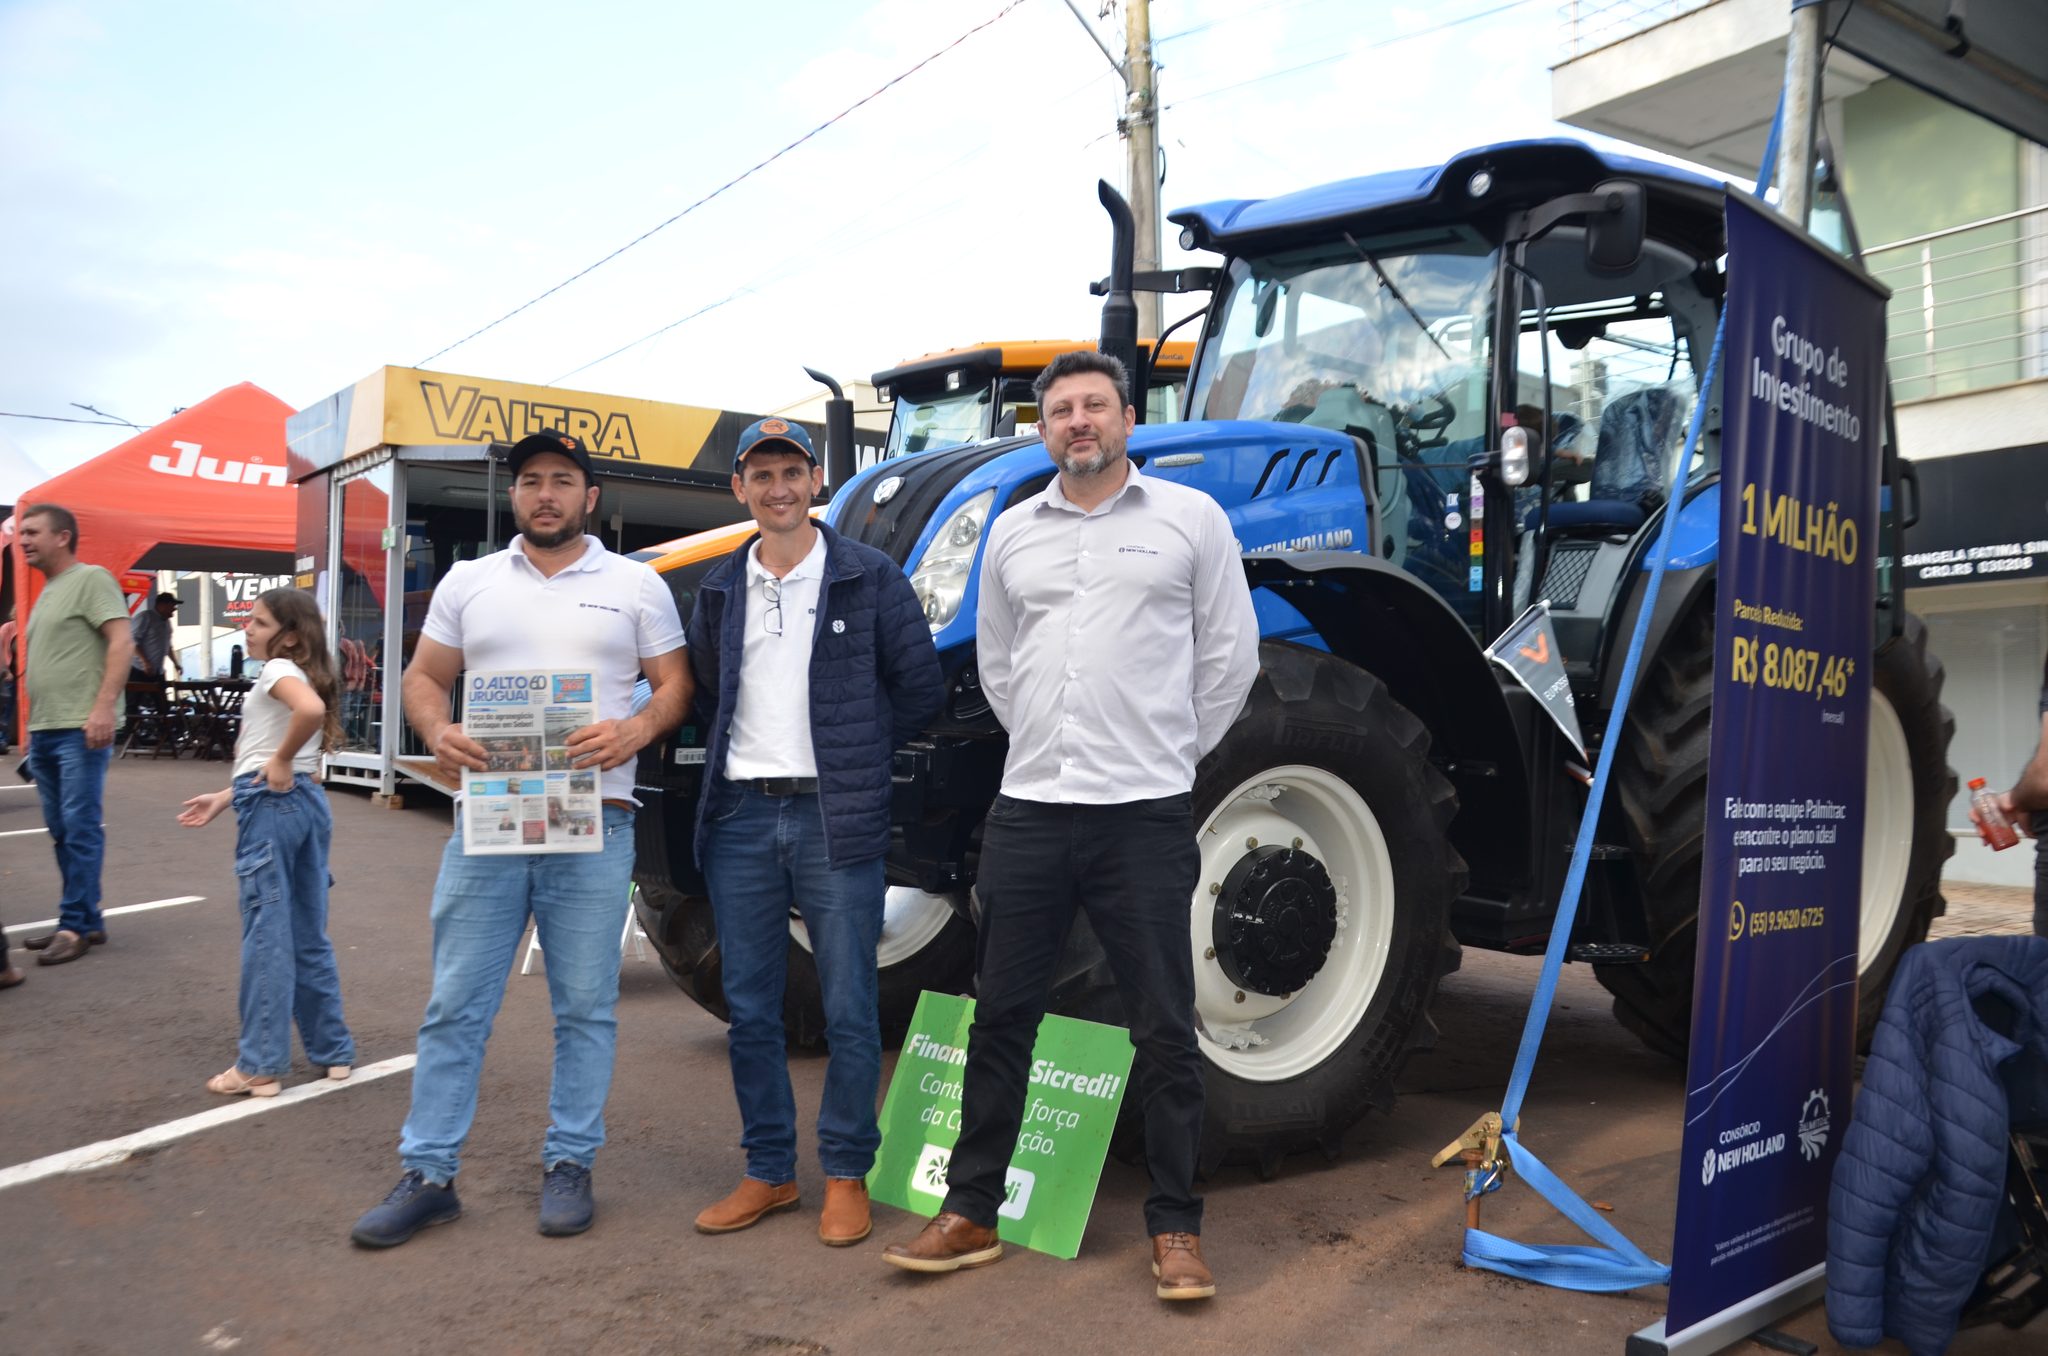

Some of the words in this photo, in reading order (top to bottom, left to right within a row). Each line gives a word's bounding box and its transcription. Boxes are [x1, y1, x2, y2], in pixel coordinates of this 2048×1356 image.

[1771, 315, 1824, 376] Grupo
[1827, 346, 1848, 388] de
[1753, 356, 1860, 442] Investimento
[420, 380, 641, 460] VALTRA
[1742, 483, 1757, 536] 1
[1762, 489, 1858, 565] MILHÃO
[1732, 634, 1759, 690] R$
[469, 690, 528, 702] URUGUAI
[473, 677, 484, 690] O
[487, 676, 528, 690] ALTO
[1743, 802, 1766, 819] com
[1767, 803, 1773, 819] a
[1774, 799, 1804, 822] equipe
[1805, 799, 1846, 819] Palmitrac
[1739, 826, 1781, 846] encontre
[1781, 831, 1789, 845] o
[1790, 824, 1815, 848] plano
[1815, 824, 1837, 844] ideal
[1738, 857, 1763, 877] para
[1764, 857, 1770, 872] o
[1771, 856, 1788, 871] seu
[1789, 850, 1826, 874] negócio.
[1750, 911, 1768, 937] (55)
[1768, 908, 1800, 931] 9.9620
[1801, 906, 1824, 928] 6725
[1029, 1059, 1121, 1100] Sicredi!
[920, 1105, 944, 1126] da
[1023, 1098, 1080, 1132] força
[1720, 1121, 1760, 1144] CONSÓRCIO
[1718, 1147, 1741, 1173] NEW
[1741, 1133, 1785, 1164] HOLLAND
